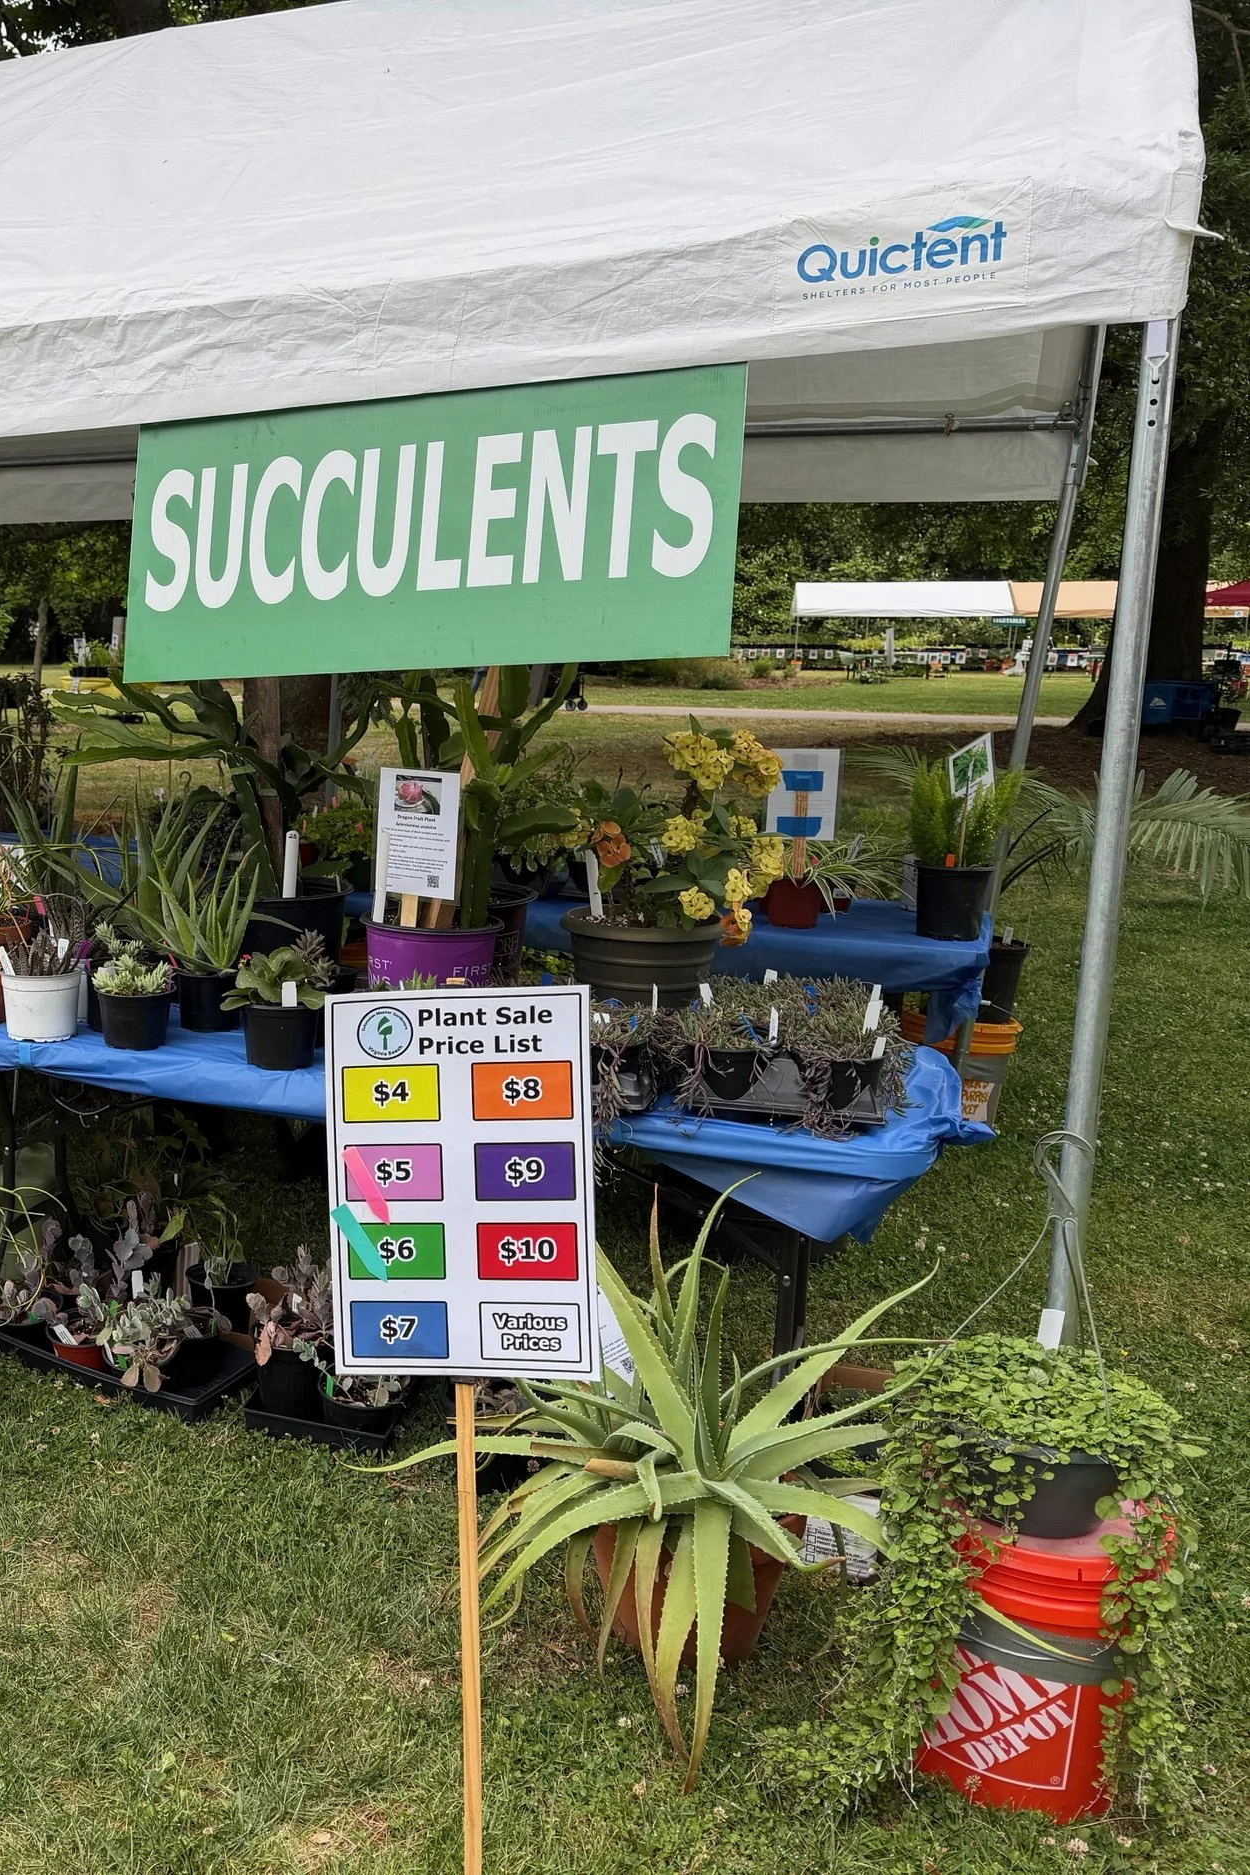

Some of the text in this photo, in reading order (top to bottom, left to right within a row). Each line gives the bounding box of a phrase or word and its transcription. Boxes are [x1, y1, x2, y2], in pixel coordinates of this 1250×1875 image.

[797, 221, 1007, 283] Quictent
[802, 271, 997, 300] SHELTERS FOR MOST PEOPLE
[144, 412, 717, 612] SUCCULENTS
[418, 1005, 552, 1027] Plant Sale
[418, 1034, 543, 1055] Price List
[373, 1078, 540, 1106] $4 $8
[376, 1159, 543, 1186] $5 $9
[379, 1238, 555, 1264] $6 $10
[381, 1312, 567, 1342] $7 Various
[502, 1333, 561, 1351] Prices
[961, 1700, 1073, 1771] DEPOT
